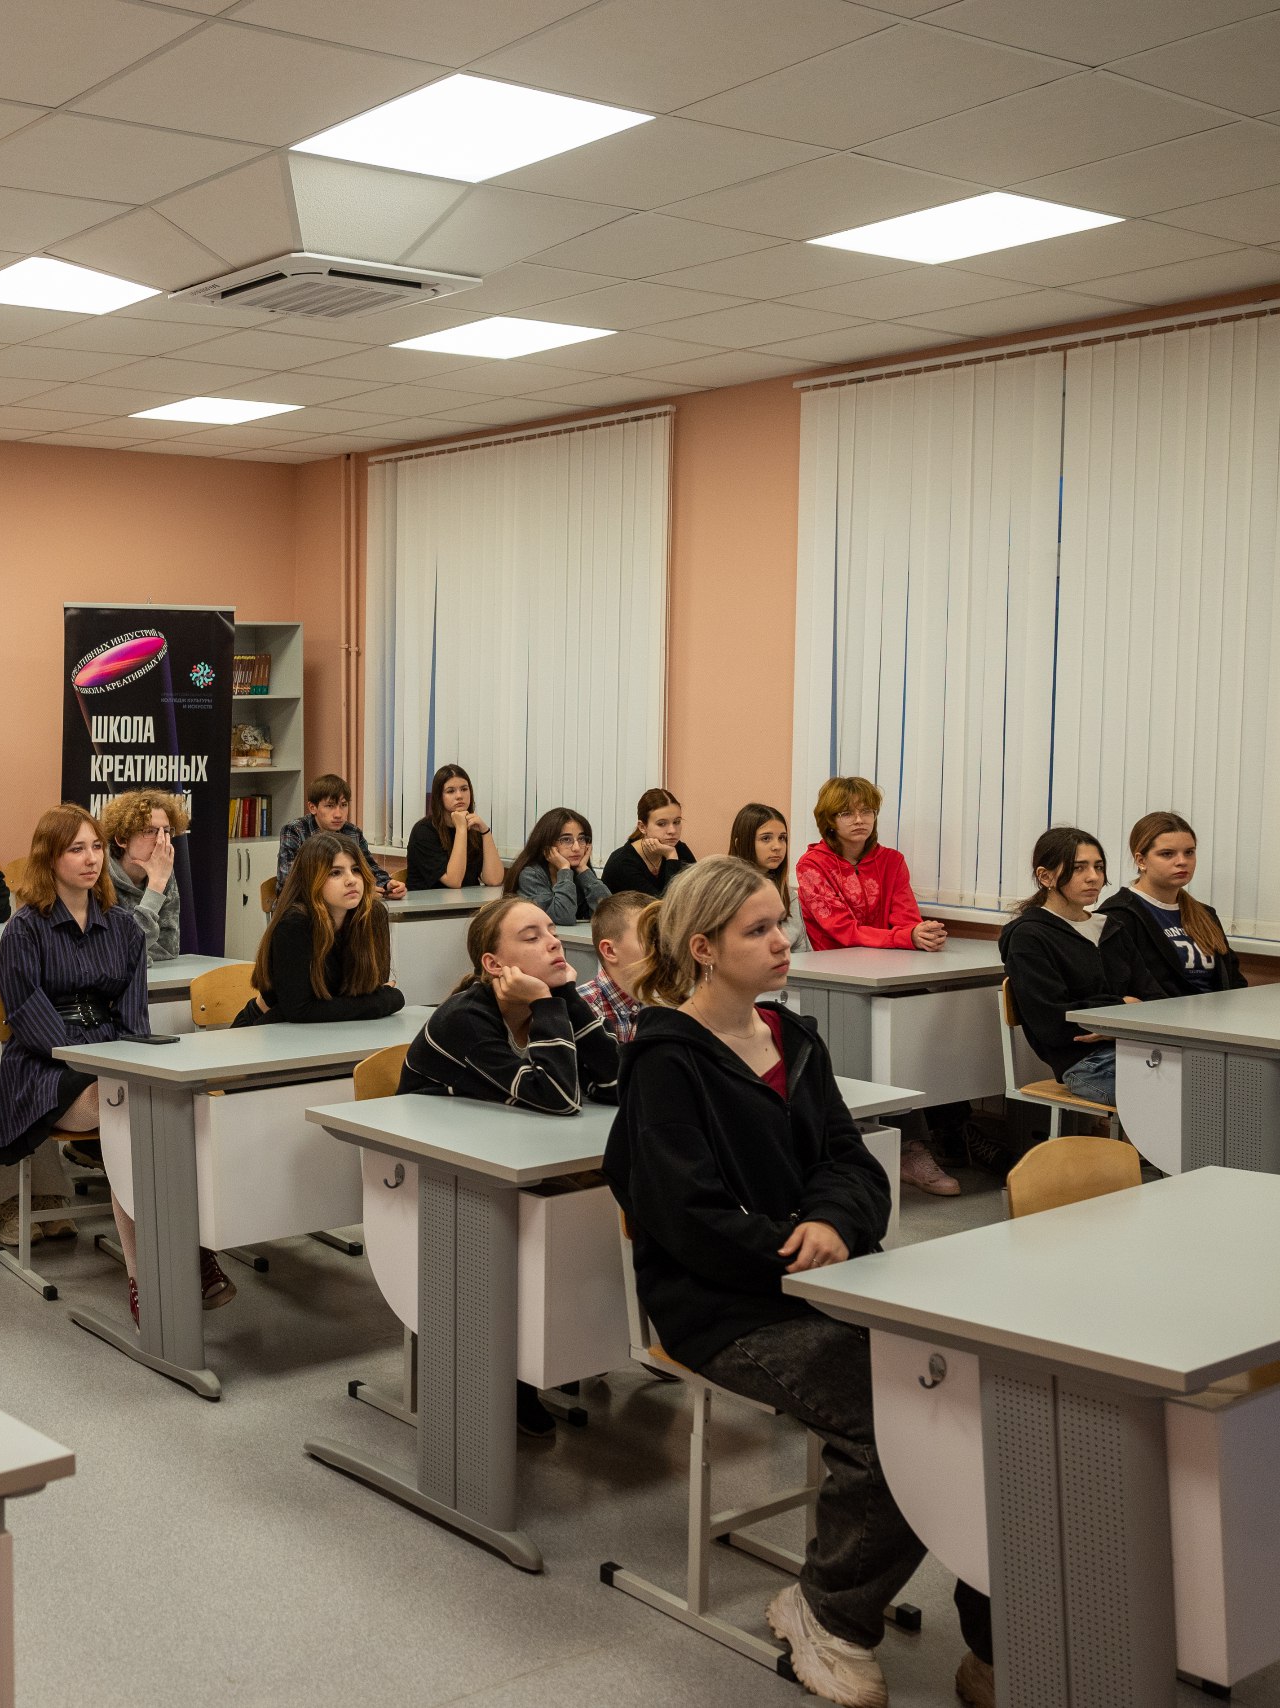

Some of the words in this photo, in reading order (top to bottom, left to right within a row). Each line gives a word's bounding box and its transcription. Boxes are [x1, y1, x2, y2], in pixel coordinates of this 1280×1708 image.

[105, 658, 159, 692] КРЕАТИВНЫХ
[91, 715, 155, 744] ШКОЛА
[90, 755, 209, 782] КРЕАТИВНЫХ
